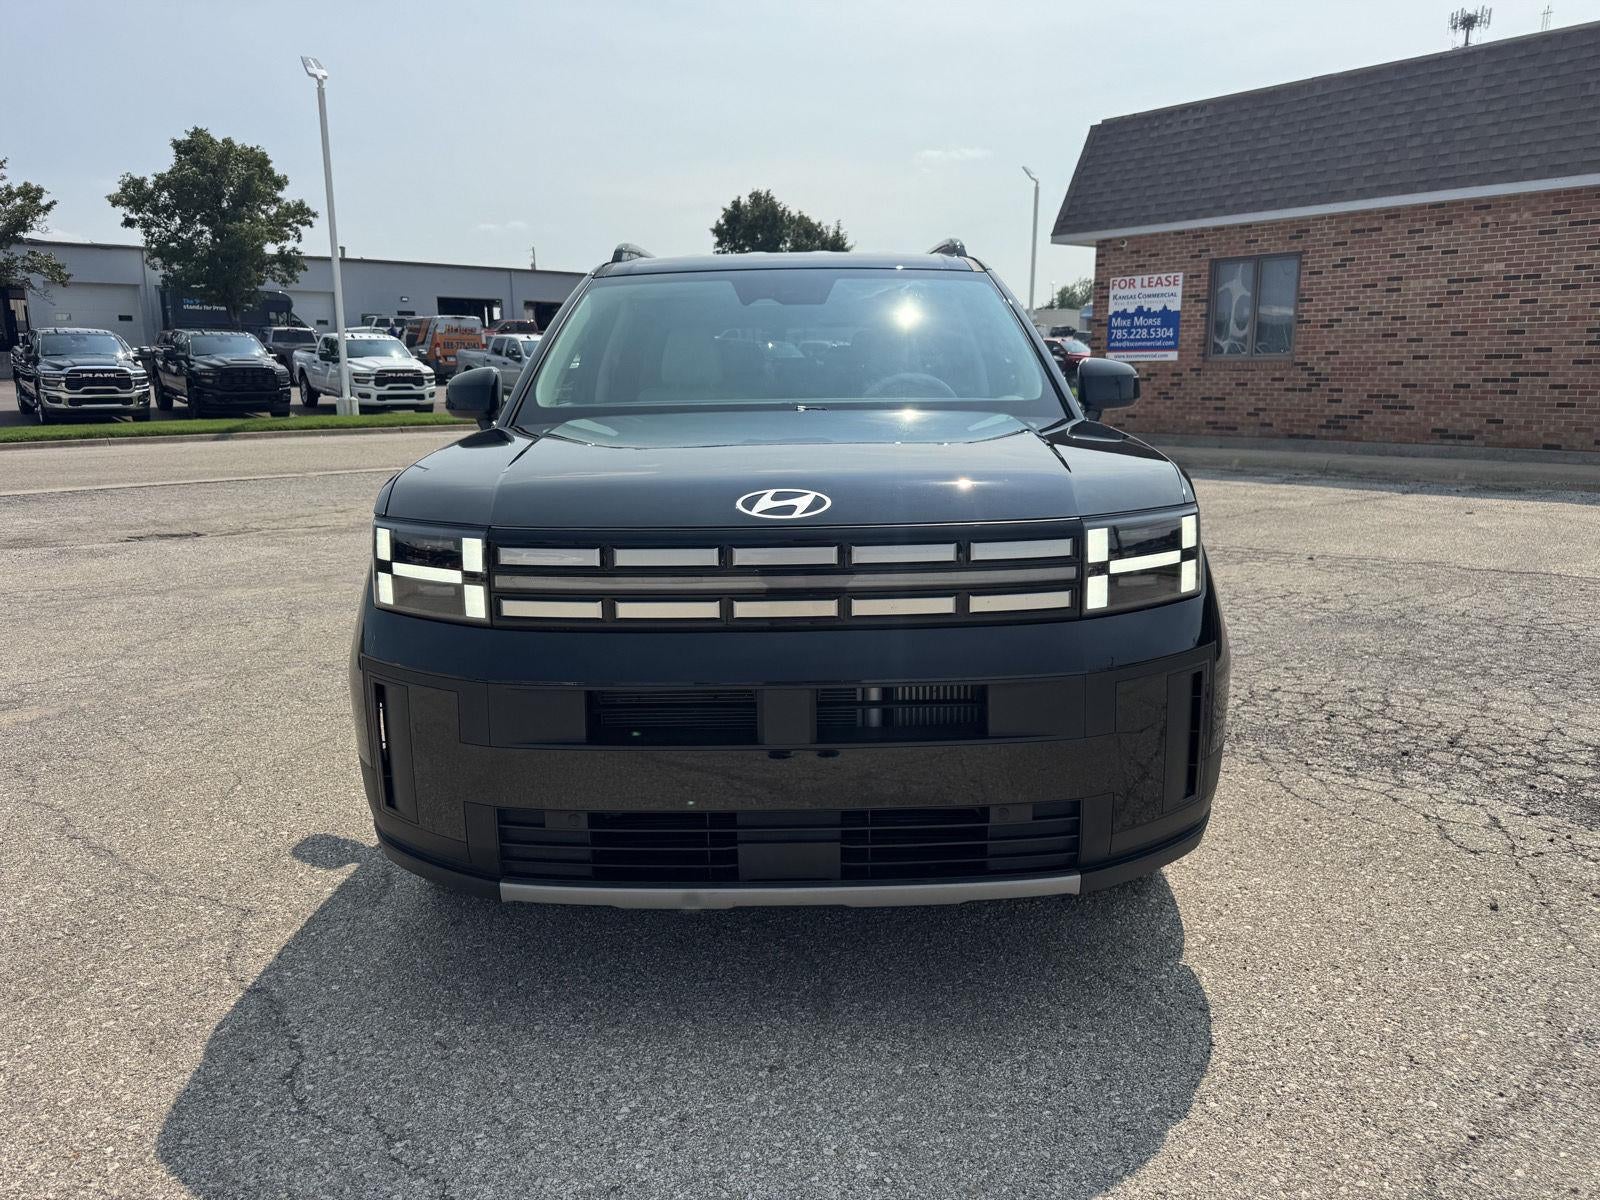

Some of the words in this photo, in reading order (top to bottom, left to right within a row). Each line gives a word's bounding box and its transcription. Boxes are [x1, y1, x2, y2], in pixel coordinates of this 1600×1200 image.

[1111, 278, 1136, 290] FOR
[1140, 275, 1180, 288] LEASE
[1111, 328, 1174, 339] 785.228.5304
